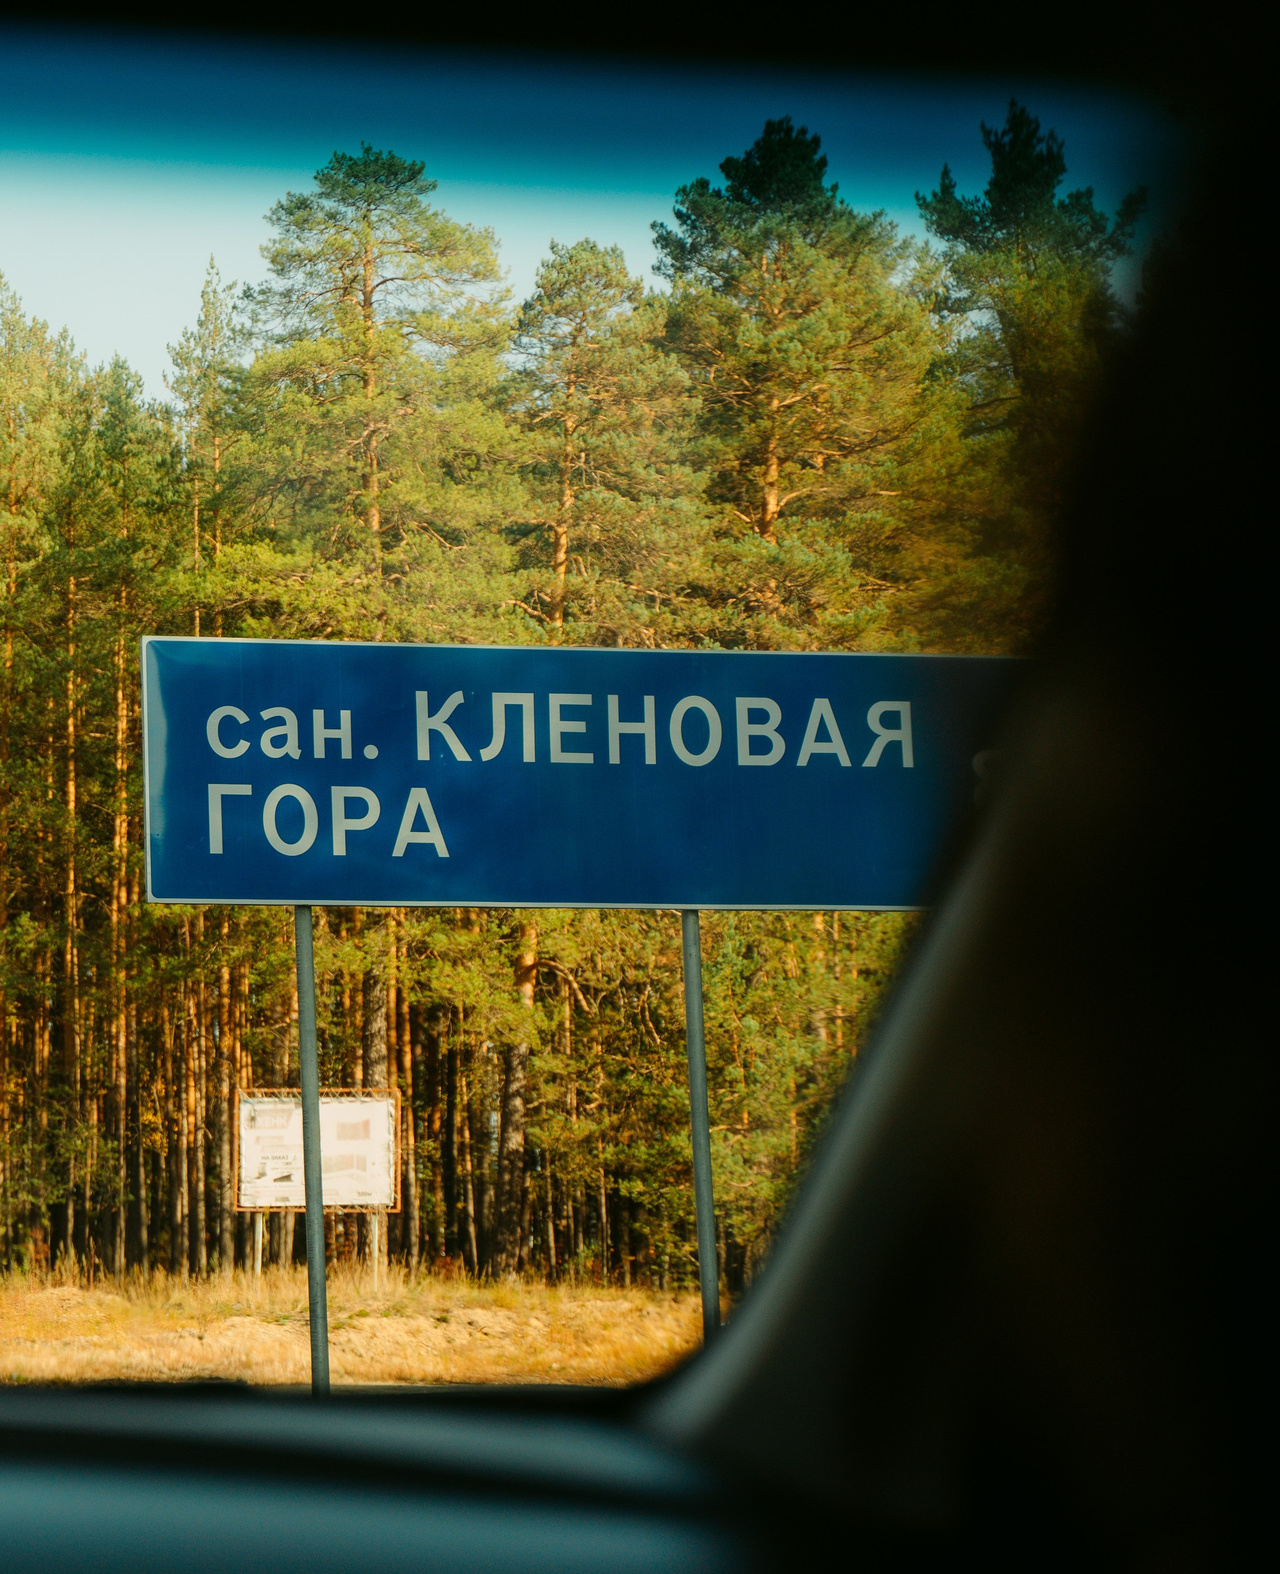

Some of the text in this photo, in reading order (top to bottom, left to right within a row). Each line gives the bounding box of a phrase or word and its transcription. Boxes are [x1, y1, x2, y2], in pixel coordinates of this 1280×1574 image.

[206, 690, 915, 768] сан. КЛЕНОВАЯ
[207, 783, 450, 858] ГОРА
